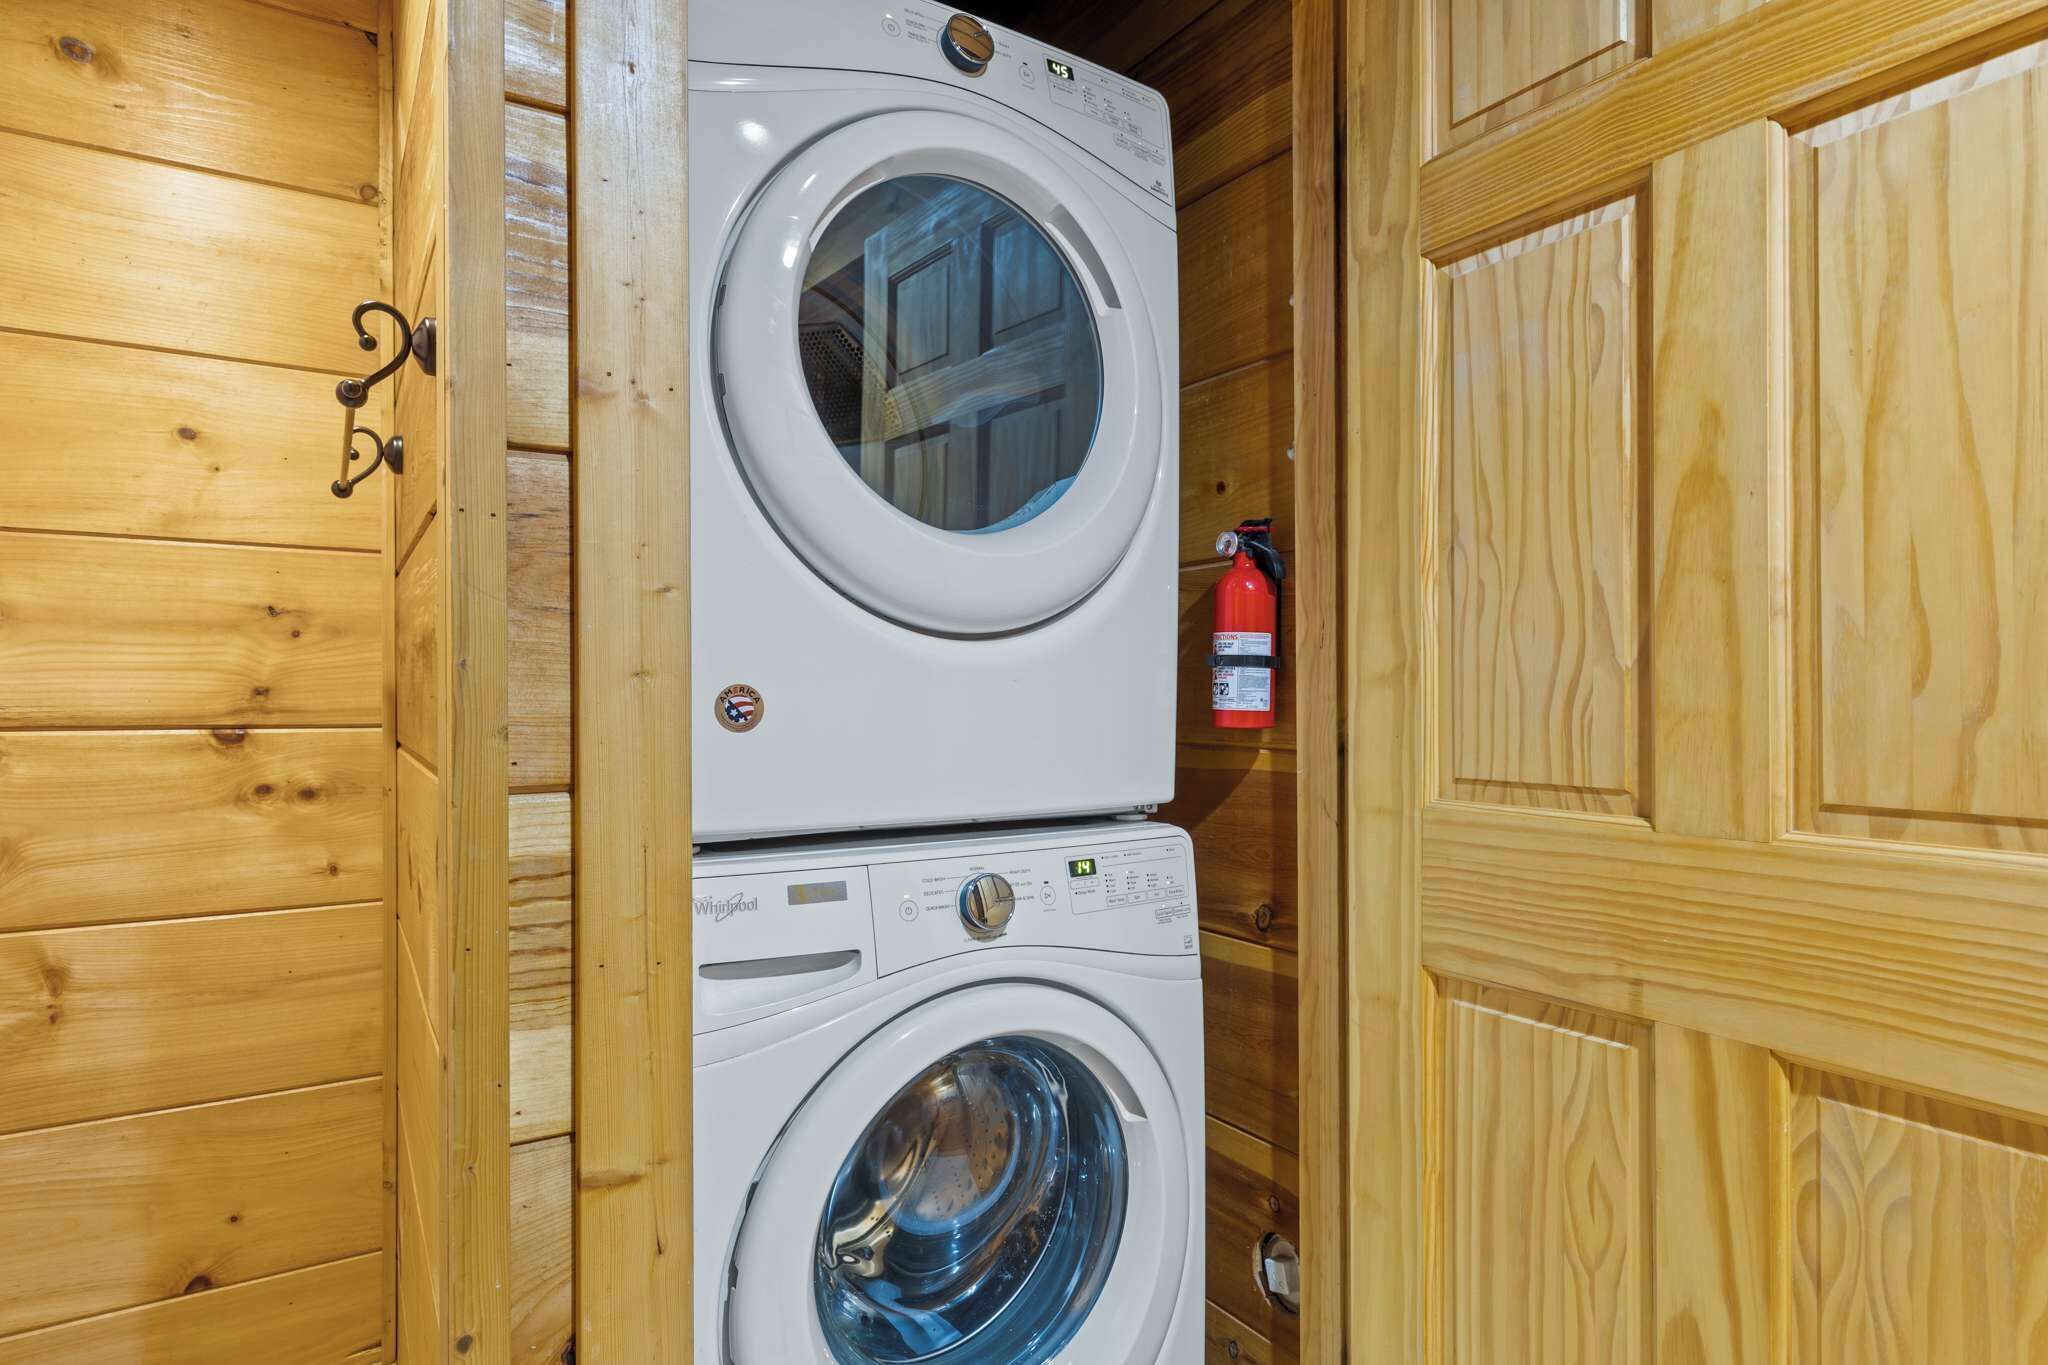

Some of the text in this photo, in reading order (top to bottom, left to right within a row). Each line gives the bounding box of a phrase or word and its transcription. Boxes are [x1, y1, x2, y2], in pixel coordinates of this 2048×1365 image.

[1052, 62, 1069, 79] 45
[720, 686, 760, 704] AMERICA
[1077, 860, 1090, 874] 14
[693, 894, 758, 918] Whirlpool
